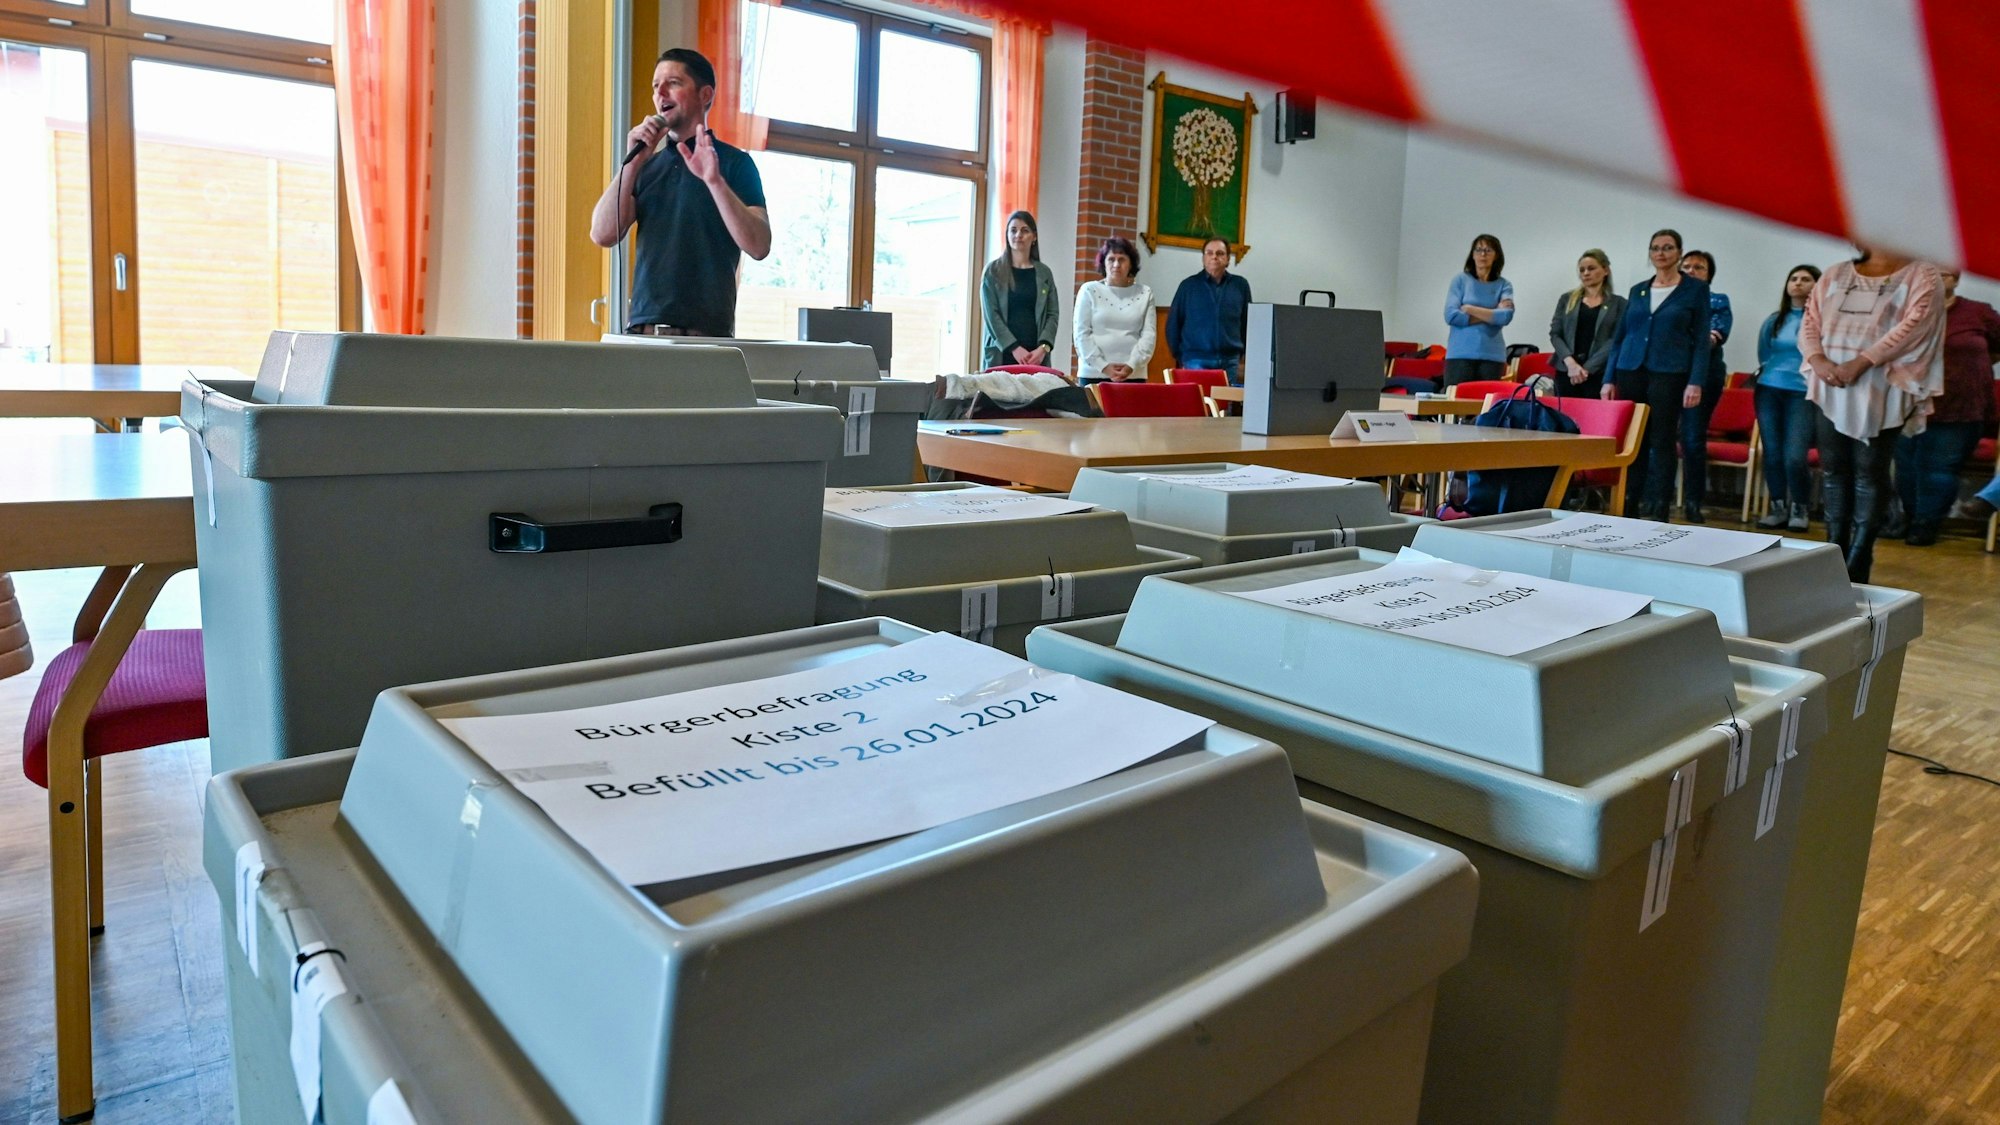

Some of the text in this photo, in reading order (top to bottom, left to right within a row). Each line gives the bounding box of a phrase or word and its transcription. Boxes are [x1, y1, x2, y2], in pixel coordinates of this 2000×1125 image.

[1285, 576, 1434, 607] Bürgerbefragung
[1373, 591, 1437, 610] Kiste 7
[1417, 612, 1460, 621] bis
[1446, 586, 1539, 615] 08.02.2024
[574, 668, 928, 740] Bürgerbefragung
[584, 690, 1059, 800] Befüllt bis 26.01.2024
[731, 711, 879, 749] Kiste 2
